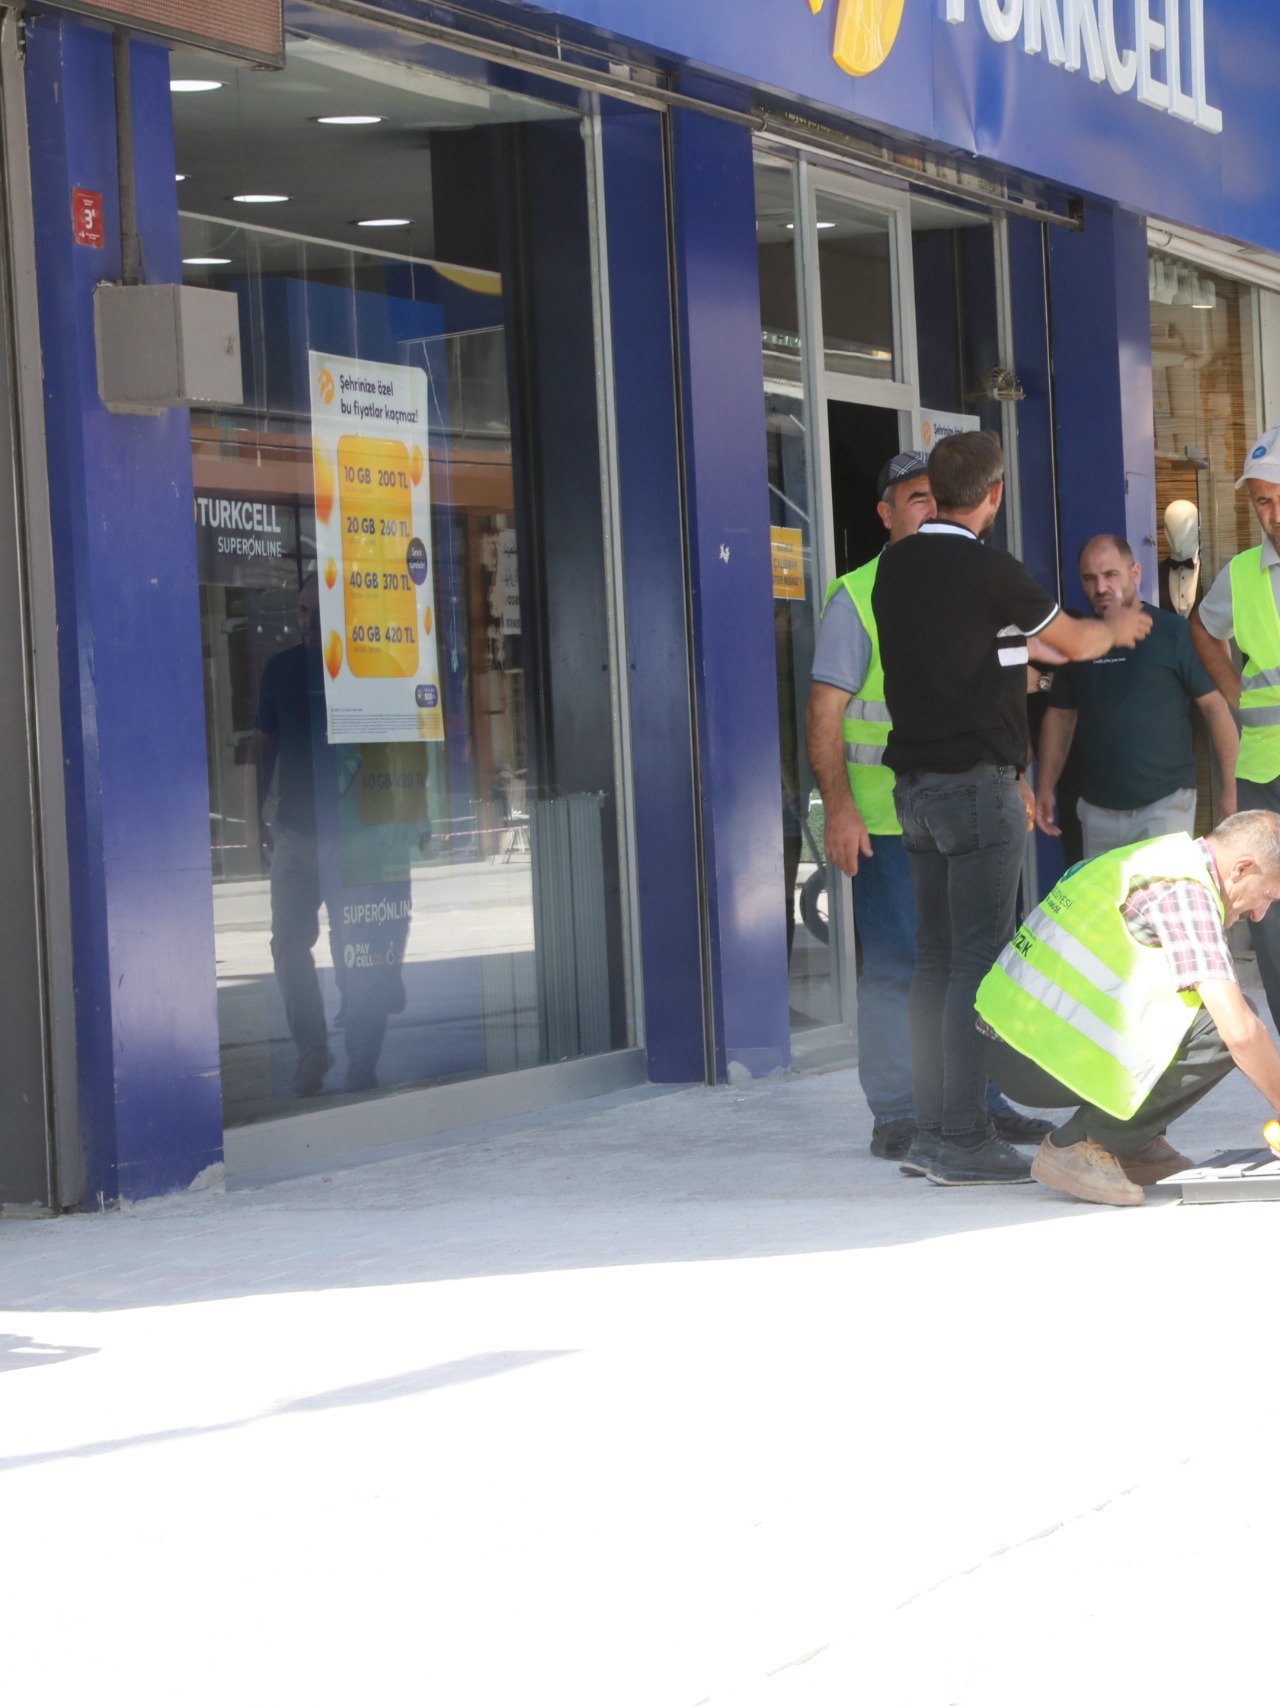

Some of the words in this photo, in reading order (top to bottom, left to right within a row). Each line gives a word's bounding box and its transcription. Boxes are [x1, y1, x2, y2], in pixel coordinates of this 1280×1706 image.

[339, 374, 376, 394] Şehrinize
[377, 380, 394, 397] özel
[340, 398, 352, 414] bu
[353, 400, 383, 420] fiyatlar
[385, 404, 419, 424] kaçmaz!
[344, 465, 355, 483] 10
[357, 466, 372, 484] GB
[377, 469, 396, 487] 200
[398, 471, 409, 489] TL
[197, 497, 282, 533] TURKCELL
[346, 516, 359, 534] 20
[361, 518, 376, 535] GB
[380, 519, 397, 537] 260
[399, 521, 410, 538] TL
[350, 571, 362, 589] 40
[364, 572, 379, 589] GB
[383, 573, 399, 591] 370
[400, 574, 412, 591] TL
[352, 625, 365, 642] 60
[367, 626, 381, 642] GB
[385, 626, 403, 643] 420
[404, 627, 416, 644] TL
